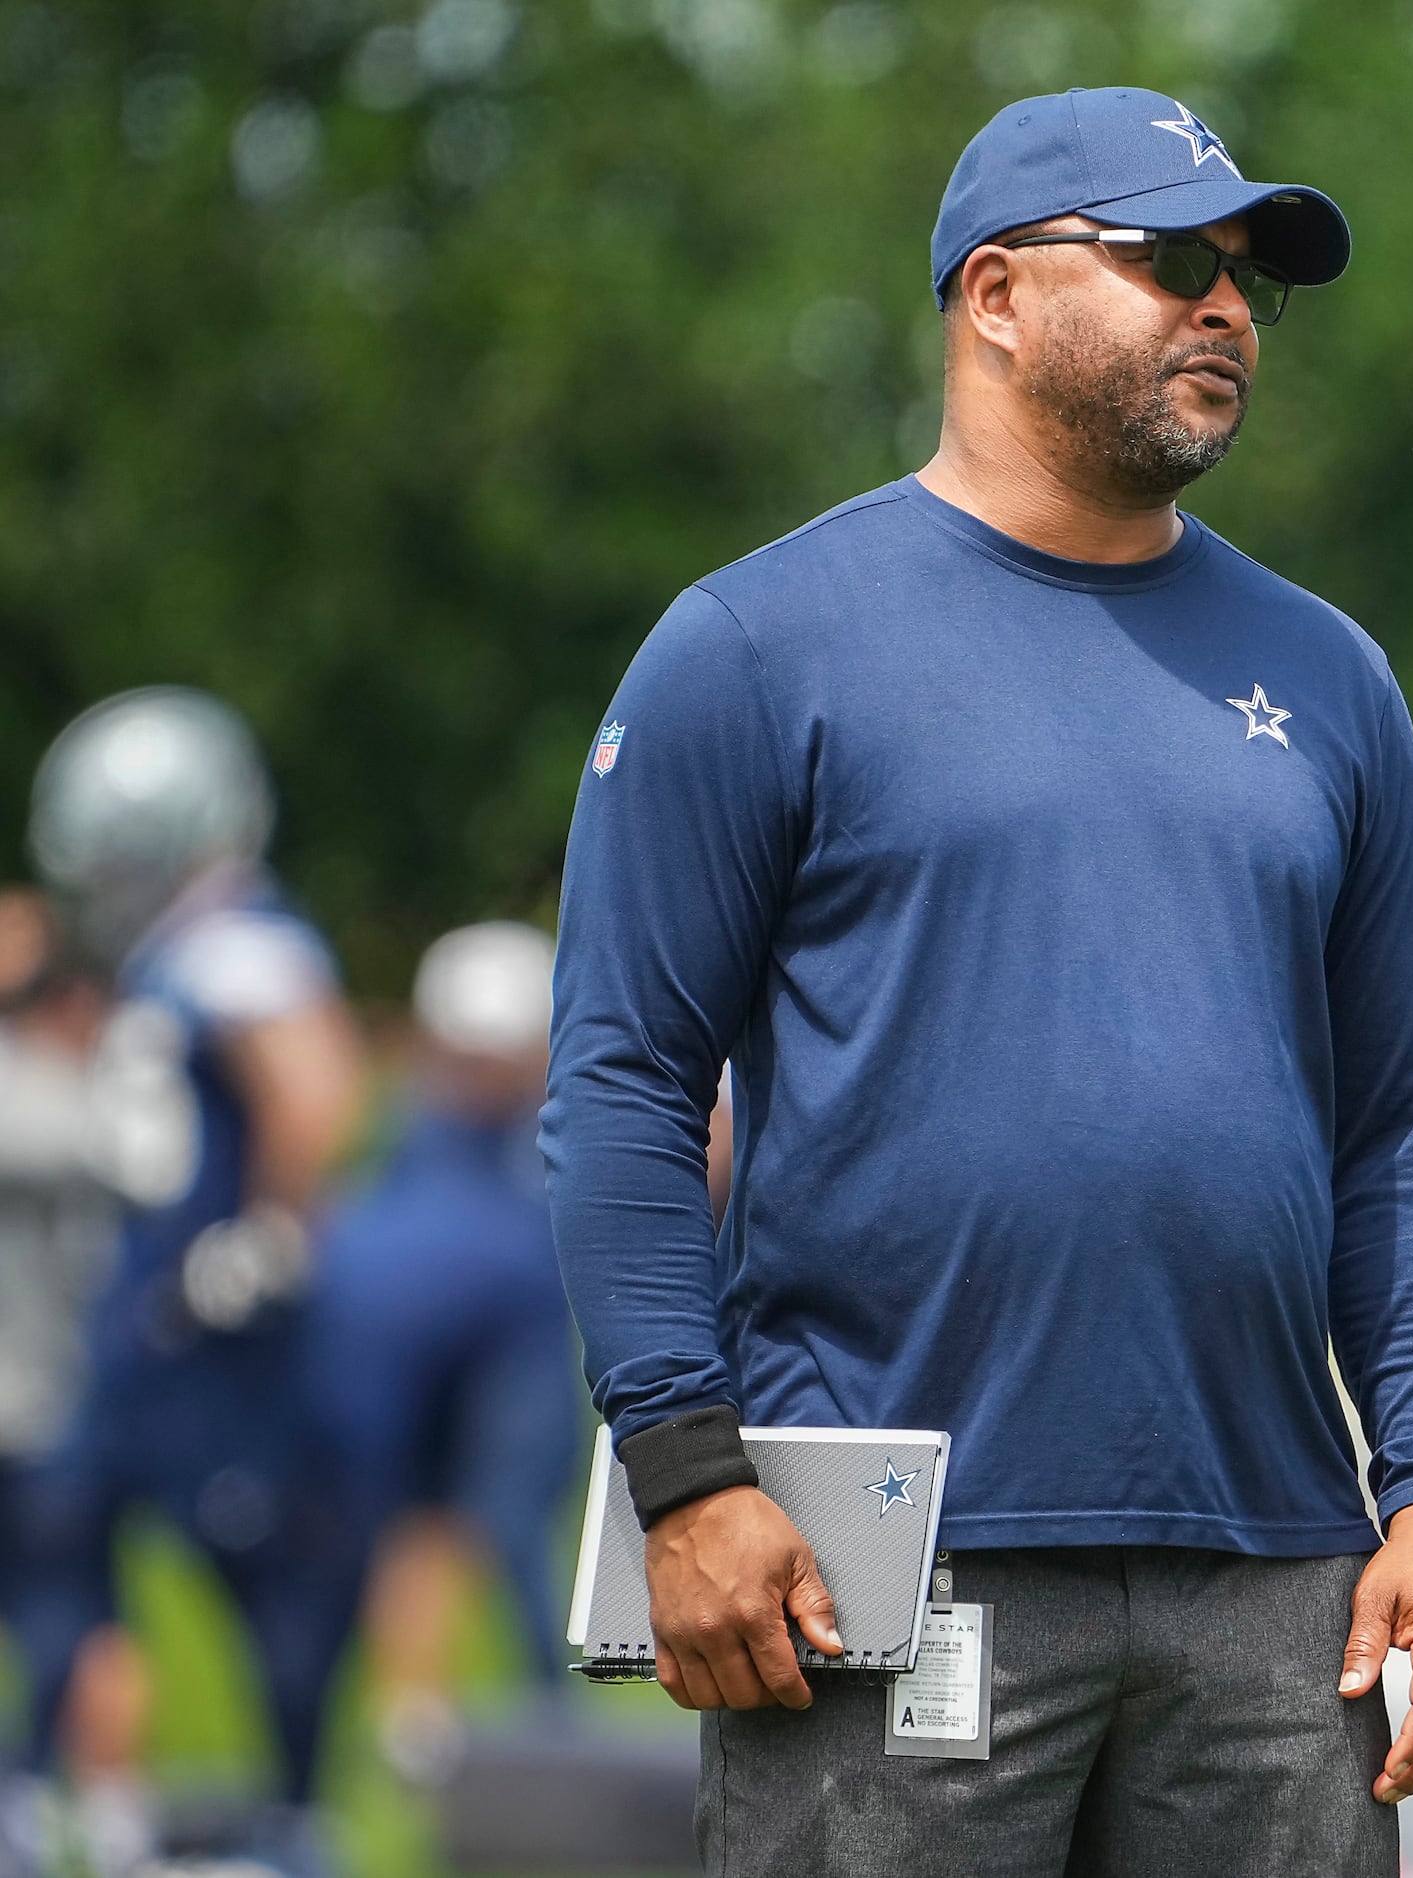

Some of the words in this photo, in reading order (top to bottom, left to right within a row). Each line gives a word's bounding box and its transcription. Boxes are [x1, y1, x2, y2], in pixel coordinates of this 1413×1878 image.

[595, 746, 614, 768] NFL
[938, 1624, 974, 1632] STAR
[935, 1647, 962, 1655] COWBOYS
[901, 1706, 915, 1728] A
[927, 1720, 960, 1728] ESCORTING
